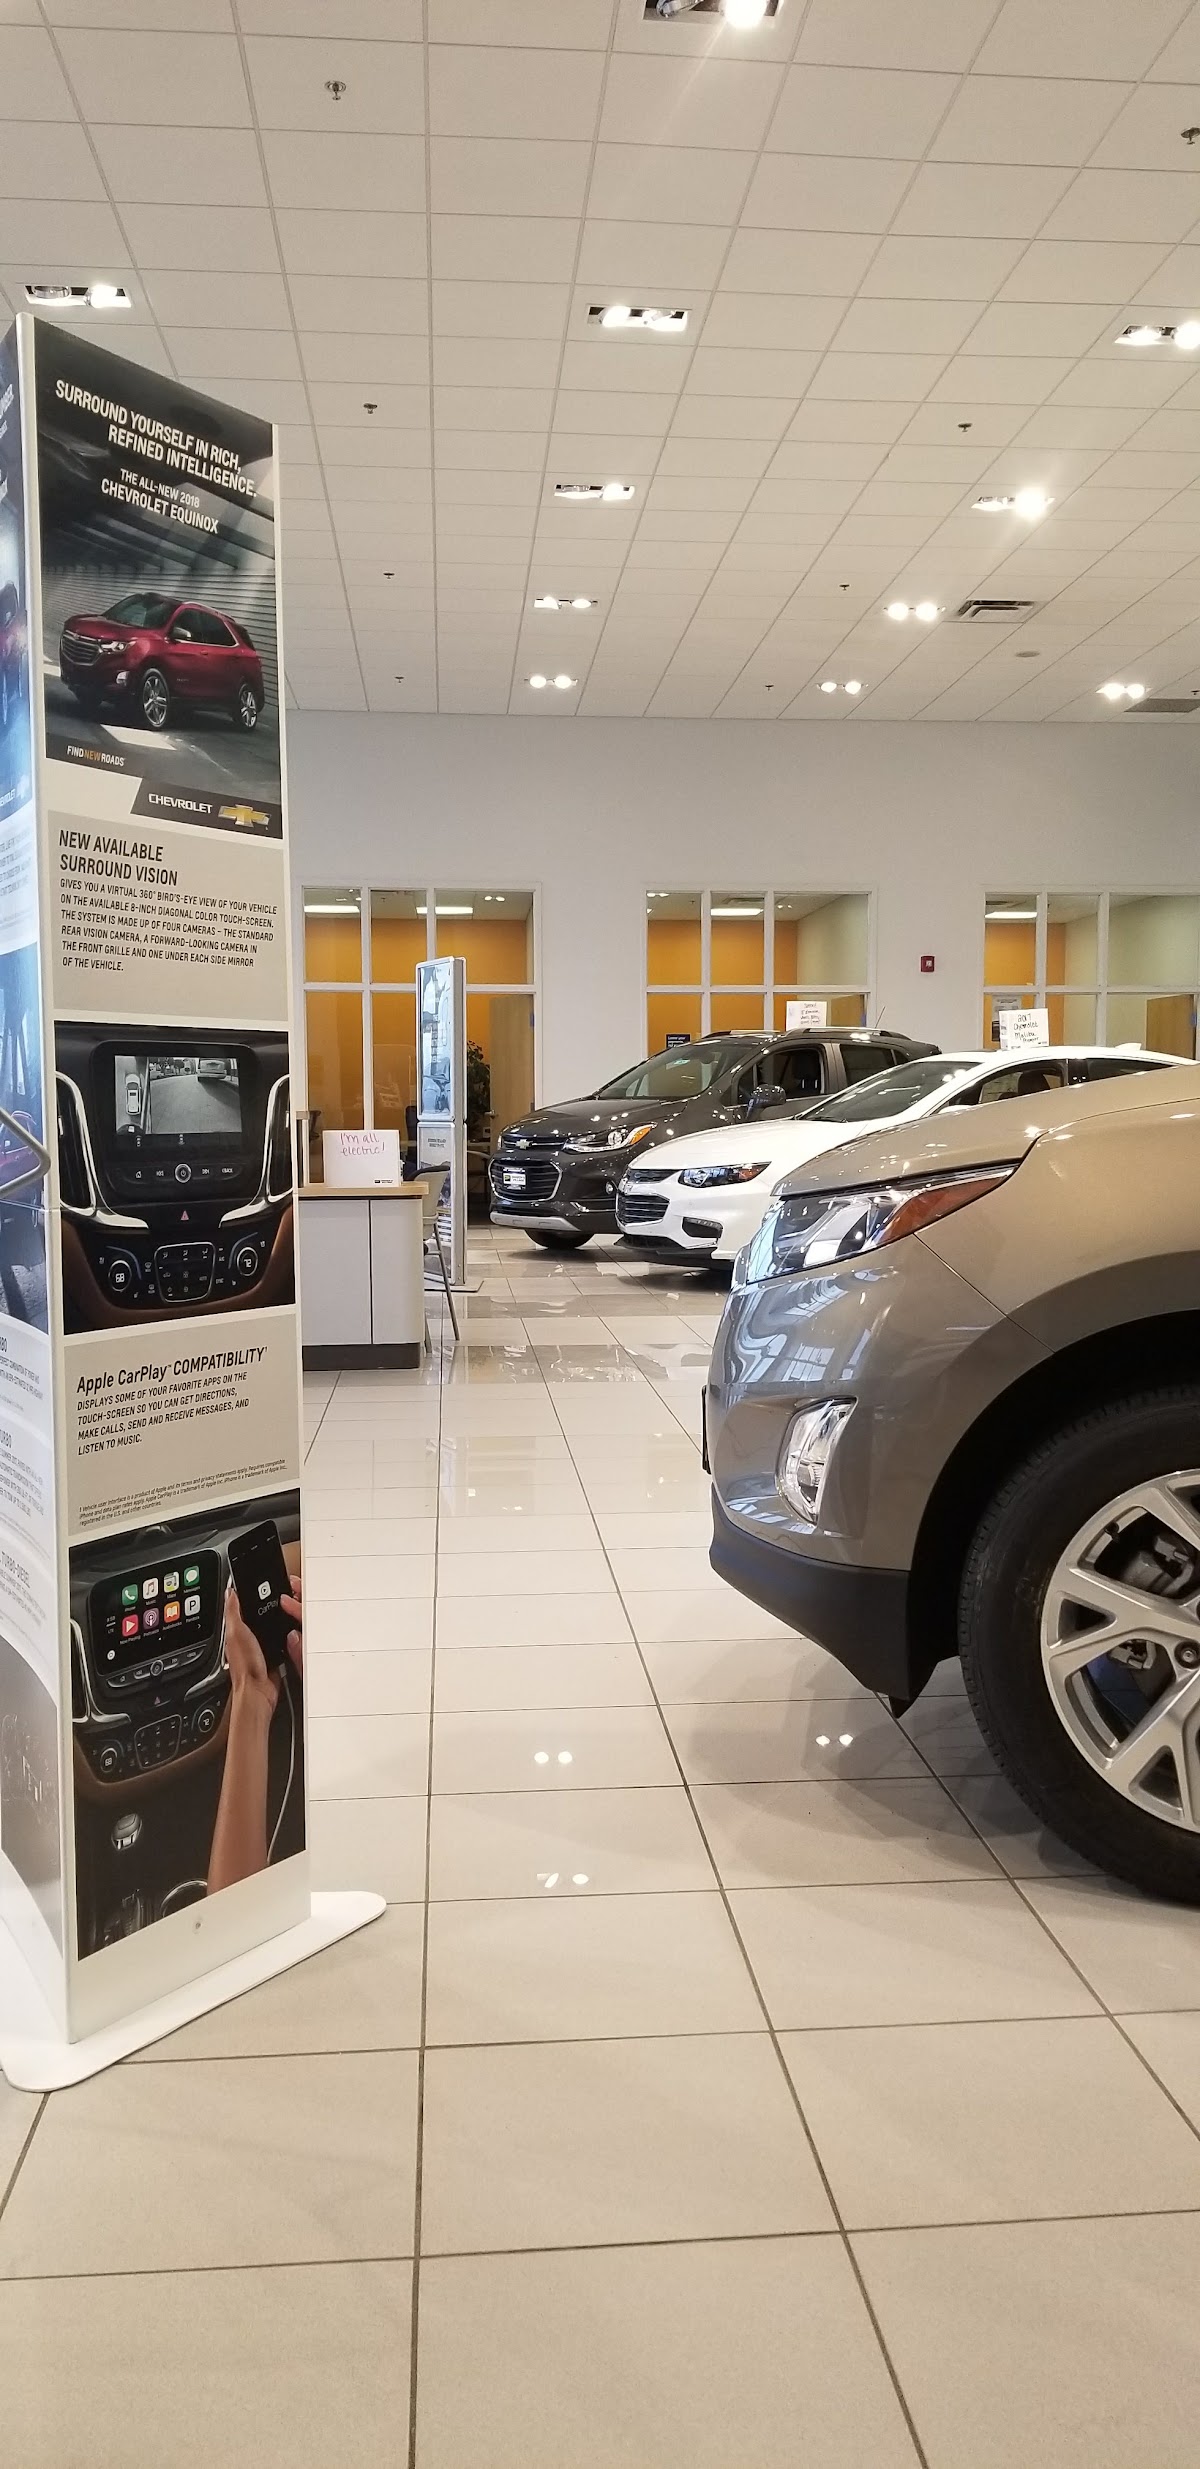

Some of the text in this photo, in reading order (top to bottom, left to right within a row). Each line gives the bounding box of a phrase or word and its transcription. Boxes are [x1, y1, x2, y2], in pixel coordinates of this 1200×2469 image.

[55, 379, 128, 425] SURROUND
[131, 411, 194, 451] YOURSELF
[195, 438, 209, 459] IN
[210, 444, 241, 474] RICH,
[108, 424, 257, 497] REFINED INTELLIGENCE.
[120, 468, 200, 509] THE ALL-NEW 2018
[101, 478, 219, 534] CHEVROLET EQUINOX
[149, 793, 213, 814] CHEVROLET
[59, 829, 164, 862] NEW AVAILABLE
[60, 854, 178, 886] SURROUND VISION
[60, 878, 82, 890] GIVES
[84, 881, 99, 892] YOU
[100, 884, 105, 893] A
[107, 885, 138, 898] VIRTUAL
[157, 891, 198, 905] BIRD'S-EYE
[199, 897, 217, 907] VIEW
[218, 900, 227, 908] OF
[229, 900, 247, 911] YOUR
[248, 903, 277, 915] VEHICLE
[60, 893, 274, 928] ON THE AVAILABLE 8-INCH DIAGONAL COLOR TOUCH-SCREEN.
[61, 909, 76, 920] THE
[77, 911, 107, 924] SYSTEM
[108, 915, 116, 925] IS
[117, 916, 138, 927] MADE
[140, 919, 149, 928] UP
[151, 920, 161, 930] OF
[162, 922, 181, 932] FOUR
[182, 923, 216, 936] CAMERAS
[223, 928, 236, 938] THE
[238, 930, 274, 941] STANDARD
[61, 925, 258, 954] REAR VISION CAMERA, A FORWARD-LOOKING CAMERA IN
[62, 940, 254, 967] THE FRONT GRILLE AND ONE UNDER EACH SIDE MIRROR
[62, 956, 124, 971] OF THE VEHICLE.
[340, 1133, 379, 1145] I'm all
[341, 1141, 384, 1156] electric!
[76, 1371, 114, 1396] Apple
[77, 1371, 248, 1411] DISPLAYS SOME OF YOUR FAVORITE APPS ON THE
[78, 1387, 238, 1425] TOUCH-SCREEN SO YOU CAN GET DIRECTIONS,
[78, 1398, 249, 1440] MAKE CALLS, SEND AND RECEIVE MESSAGES, AND
[78, 1433, 142, 1455] LISTEN TO MUSIC.
[257, 1599, 278, 1616] CarPlay
